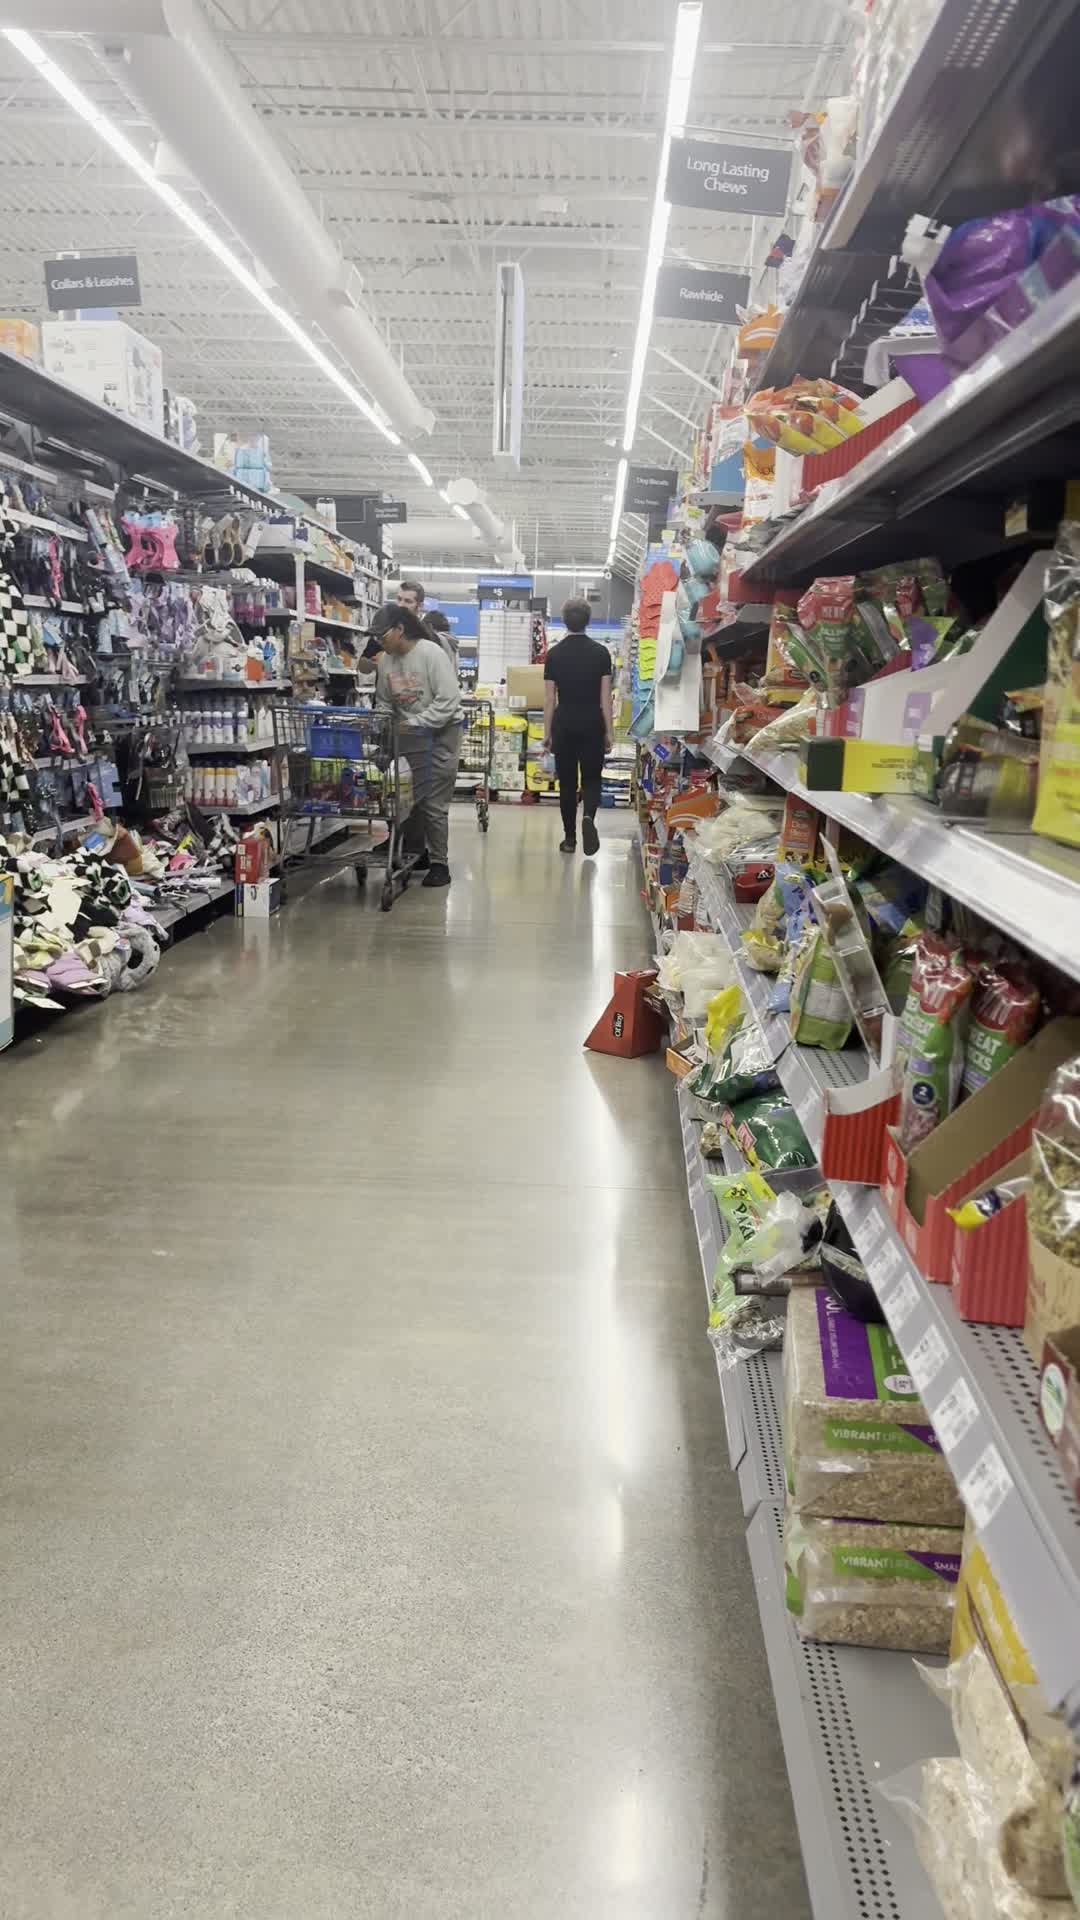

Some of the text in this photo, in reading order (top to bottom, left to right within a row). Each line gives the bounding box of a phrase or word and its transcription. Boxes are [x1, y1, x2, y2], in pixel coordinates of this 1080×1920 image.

[686, 156, 770, 182] Long Lasting
[703, 176, 748, 195] Chews
[50, 275, 135, 290] Collars & Leashes
[680, 287, 724, 302] Rawhide
[918, 1086, 928, 1096] 2
[831, 1428, 881, 1441] VIBRANT
[841, 1555, 888, 1569] VIBRANT
